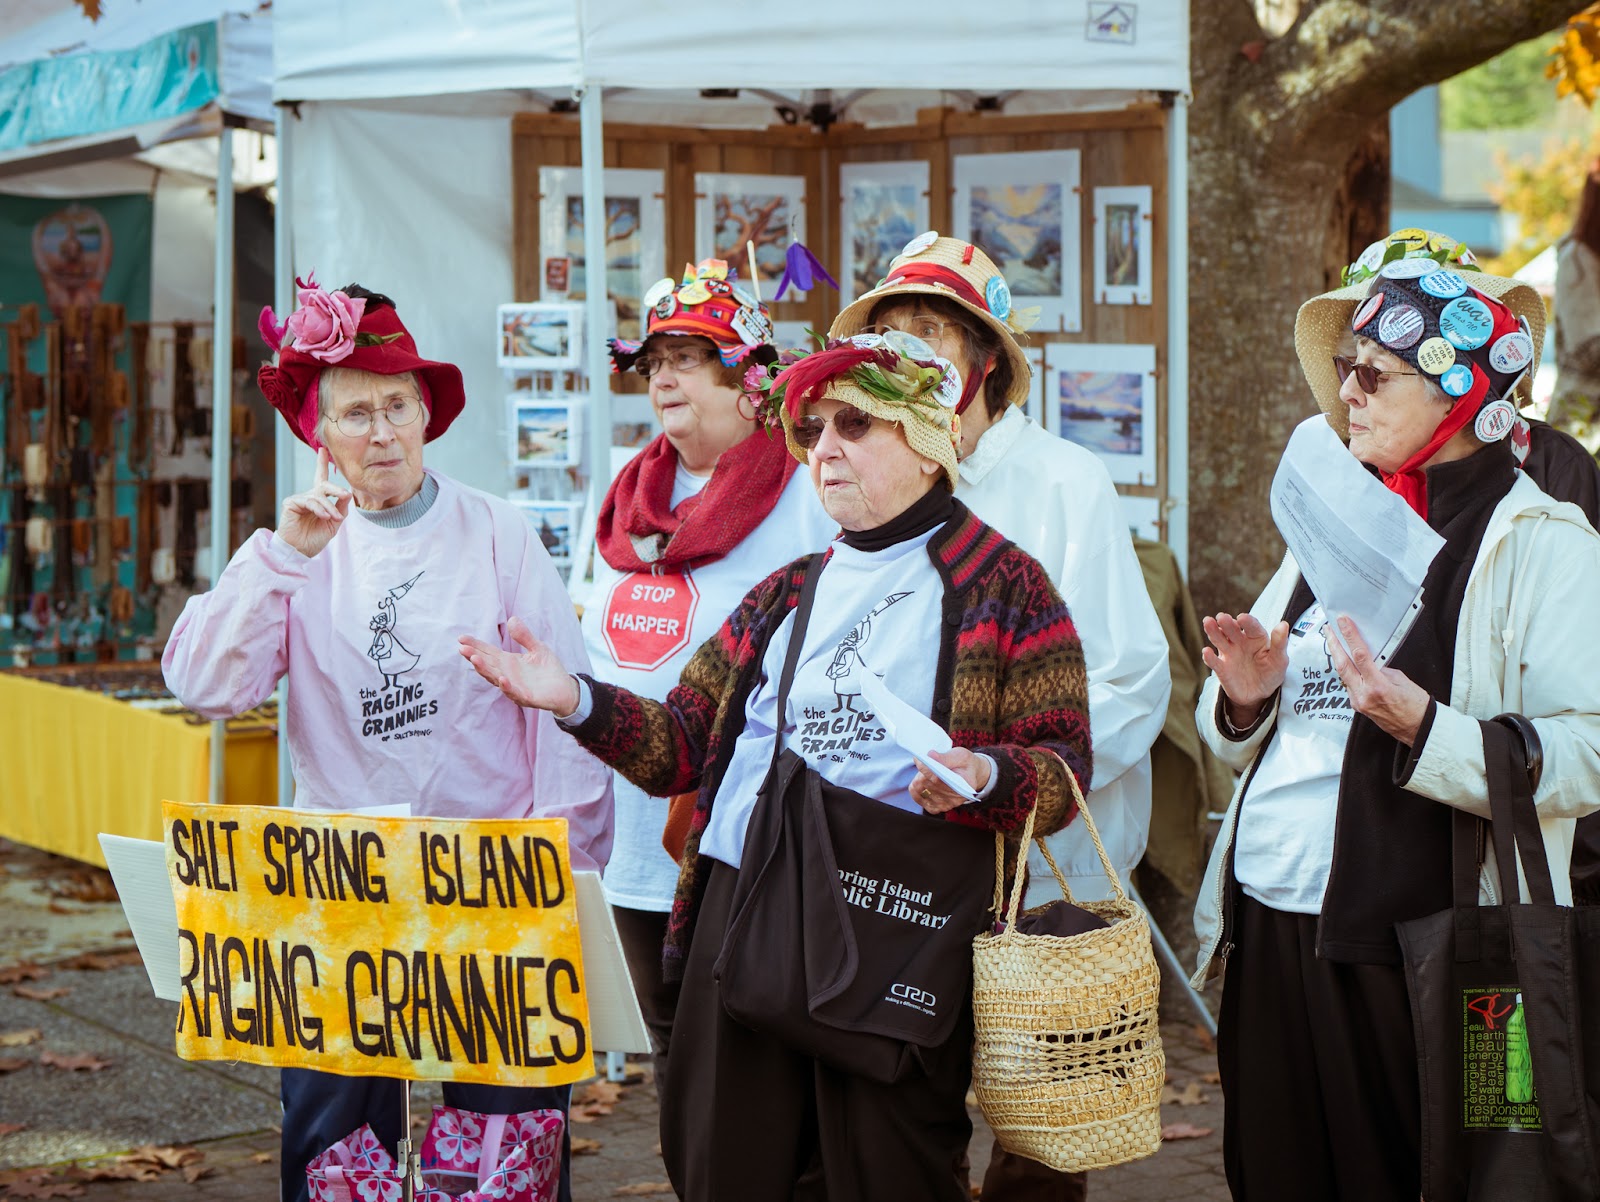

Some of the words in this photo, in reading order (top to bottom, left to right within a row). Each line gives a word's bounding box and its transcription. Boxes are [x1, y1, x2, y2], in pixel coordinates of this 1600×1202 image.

[1426, 351, 1436, 365] NOT
[1430, 345, 1443, 366] PEACE
[1437, 346, 1447, 359] FOR
[1441, 340, 1455, 359] TAXES
[1420, 354, 1430, 369] WAR
[631, 584, 676, 603] STOP
[612, 612, 680, 636] HARPER
[1302, 667, 1321, 680] the
[359, 687, 377, 699] the
[1299, 677, 1348, 698] RAG
[362, 682, 424, 718] RAGING
[1293, 696, 1352, 716] GRANN
[362, 699, 438, 737] GRANNIES
[803, 706, 826, 720] the
[800, 727, 887, 754] GRANIES
[172, 818, 239, 892] SALT
[263, 822, 389, 904] SPRING
[420, 831, 566, 909] ISLAND
[880, 878, 933, 907] Island
[875, 894, 952, 930] Library
[177, 928, 325, 1054] RAGING
[345, 948, 586, 1067] GRANNIES
[890, 983, 937, 1007] CRD
[1476, 1031, 1505, 1041] earth
[1475, 1041, 1505, 1051] eau
[1468, 1052, 1505, 1062] energy
[1479, 1062, 1487, 1086] terre
[1487, 1061, 1497, 1086] eau
[1496, 1061, 1505, 1086] earth
[1479, 1086, 1504, 1095] water
[1479, 1095, 1505, 1105] eau
[1469, 1103, 1540, 1118] responsibility
[1469, 1115, 1490, 1123] earth
[1494, 1116, 1515, 1124] energy
